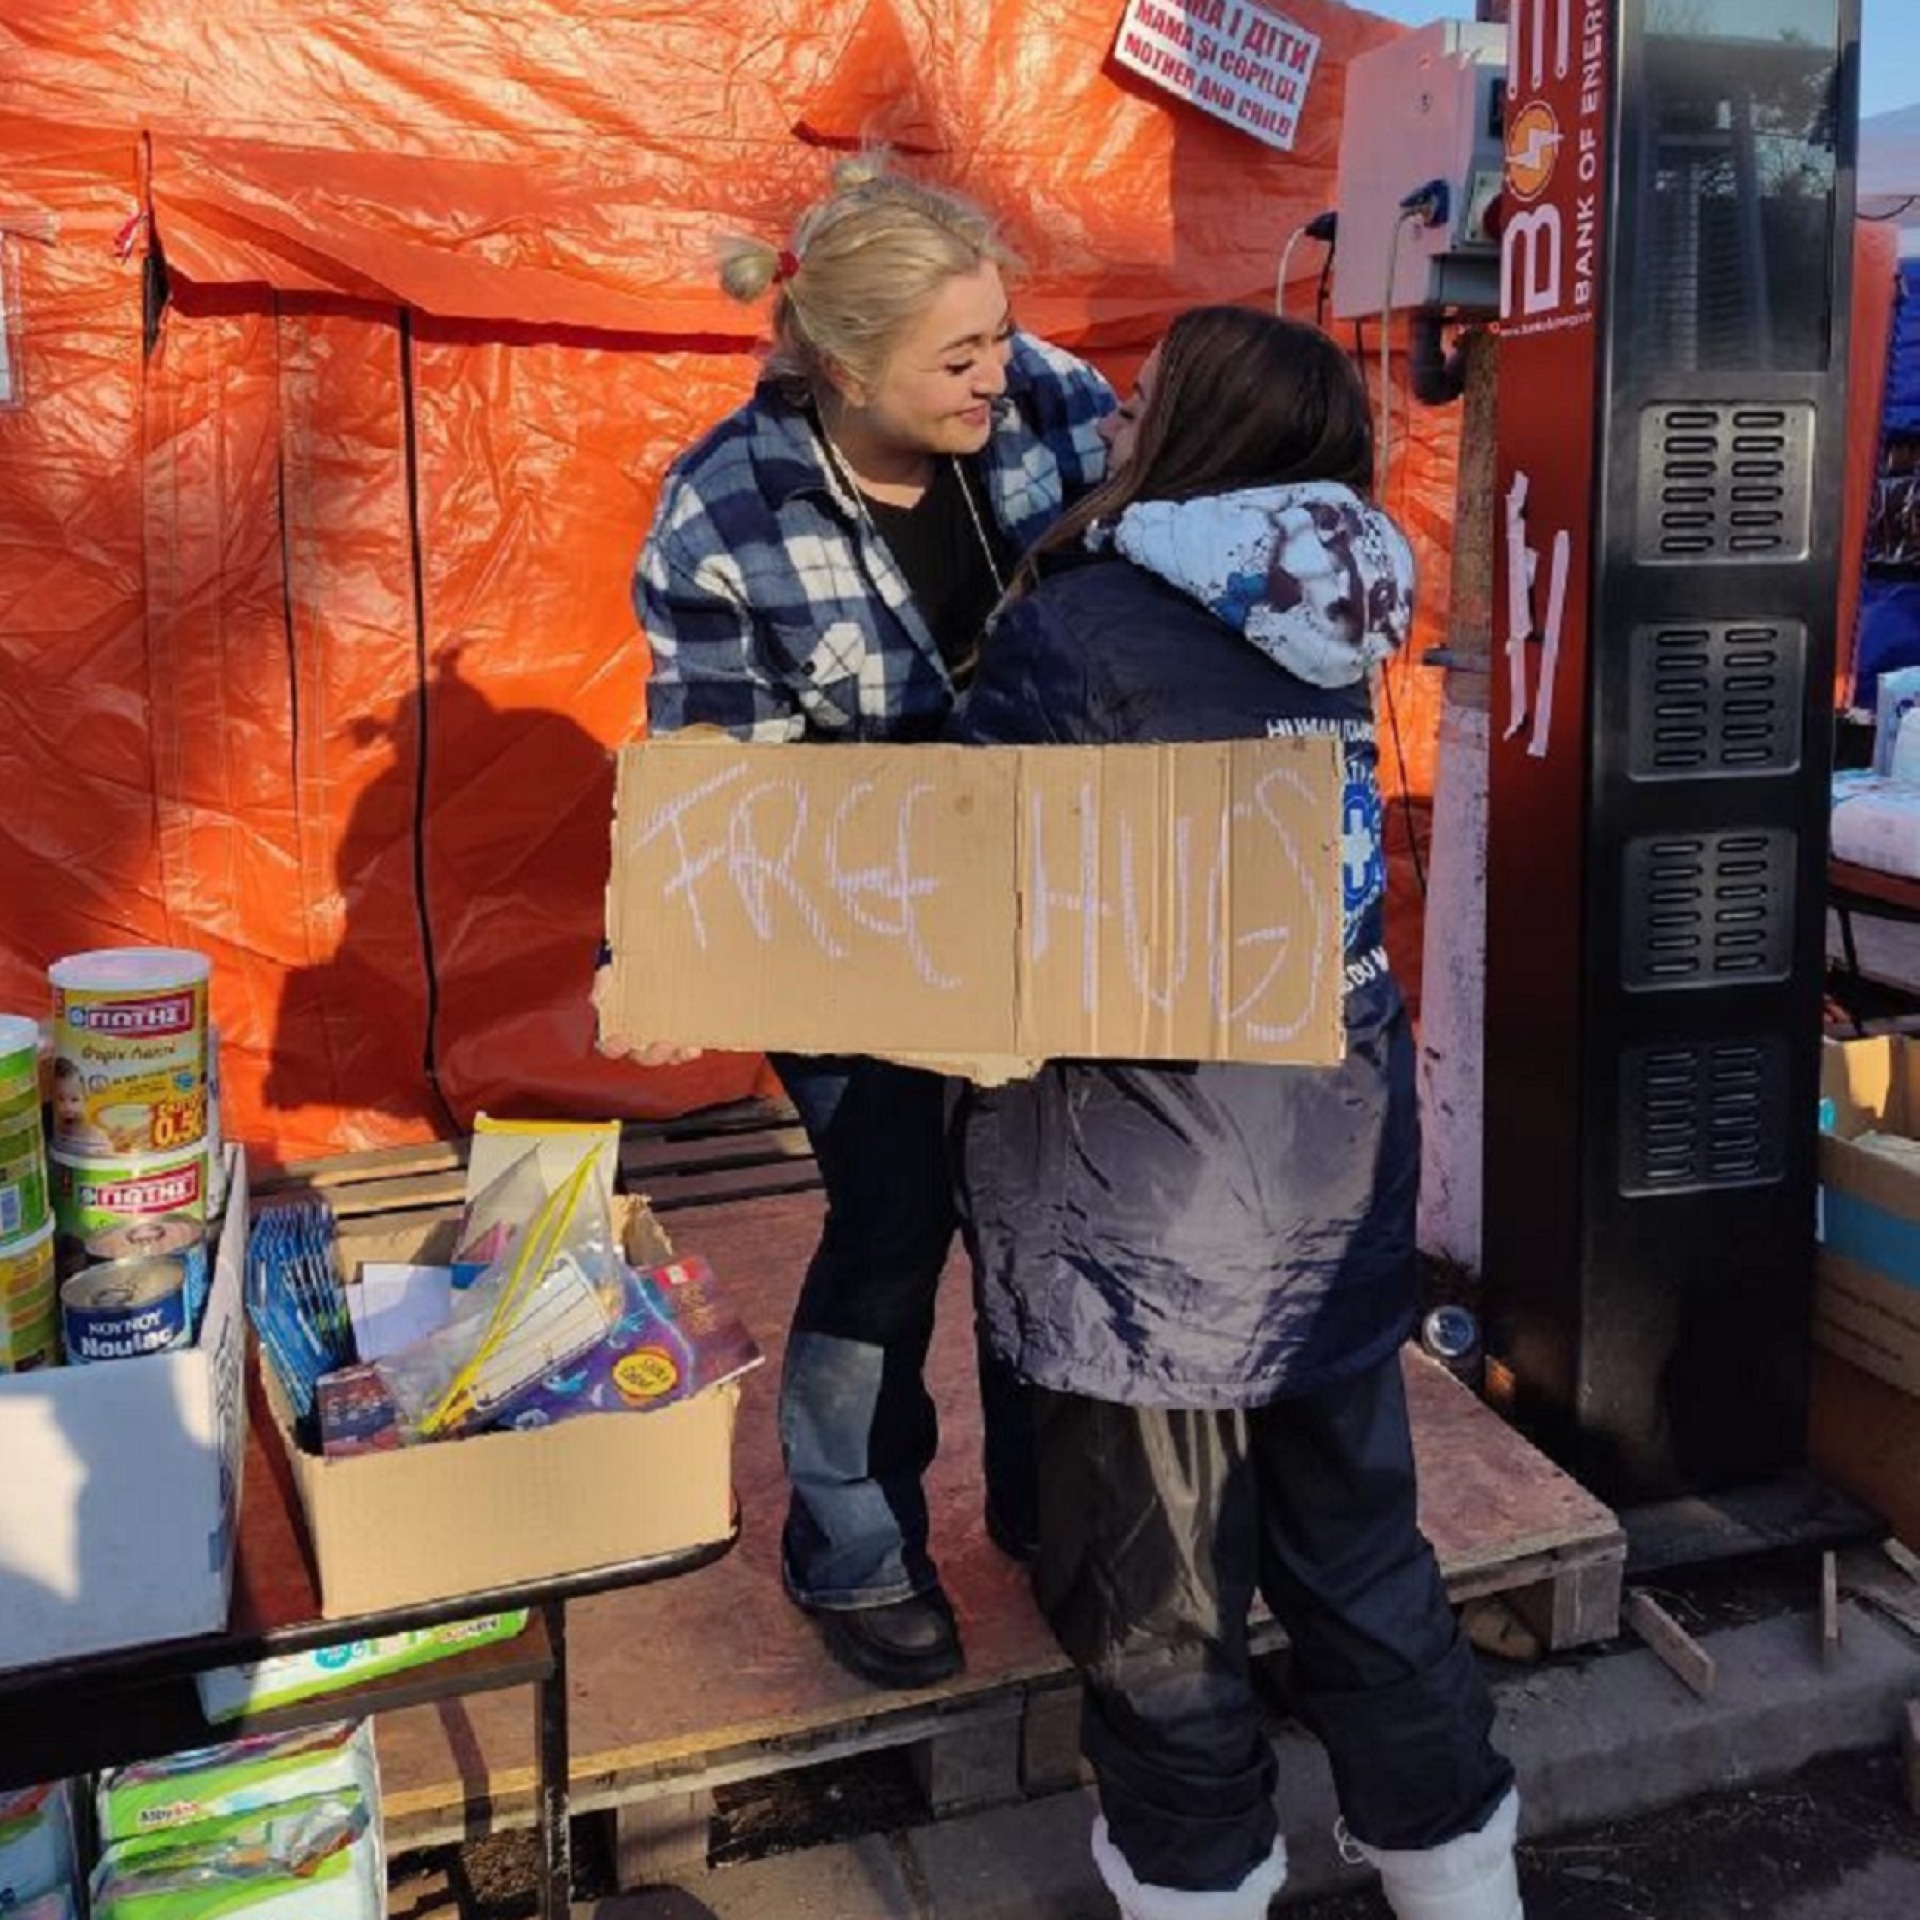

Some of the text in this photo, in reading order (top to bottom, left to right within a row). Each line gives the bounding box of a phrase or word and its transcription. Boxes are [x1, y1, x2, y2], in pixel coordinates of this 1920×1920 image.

[1124, 33, 1293, 138] MOTHER AND CHILD
[1241, 17, 1311, 75] ДІТИ
[1578, 128, 1596, 181] OF
[1574, 193, 1595, 305] BANK
[631, 762, 962, 990] FREE
[1031, 767, 1325, 1042] HUGS
[89, 1006, 178, 1027] ΓΙΩΤΗΣ
